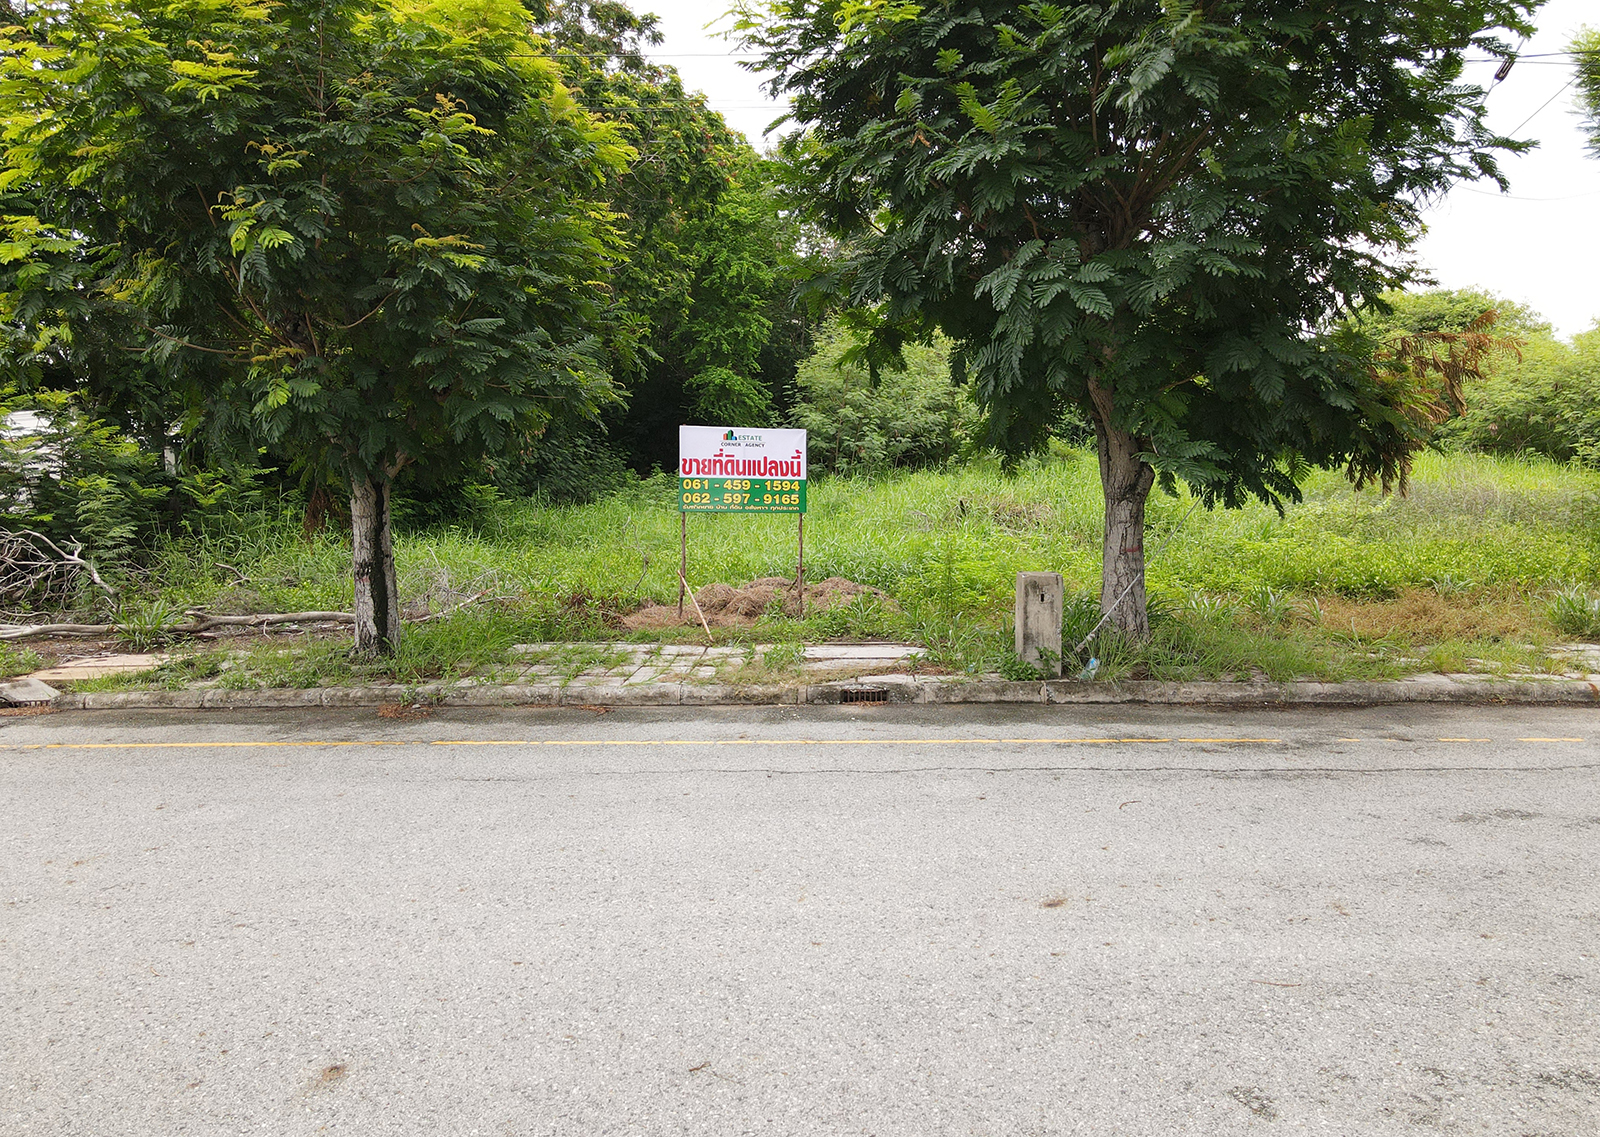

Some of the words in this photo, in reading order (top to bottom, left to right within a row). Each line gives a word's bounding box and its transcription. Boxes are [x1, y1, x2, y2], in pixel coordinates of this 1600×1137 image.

[681, 448, 802, 477] ขายที่ดินแปลงนี้
[682, 479, 709, 490] 061
[723, 479, 751, 491] 459
[764, 480, 800, 492] 1594
[682, 492, 711, 504] 062
[723, 493, 751, 504] 597
[763, 493, 800, 505] 9165
